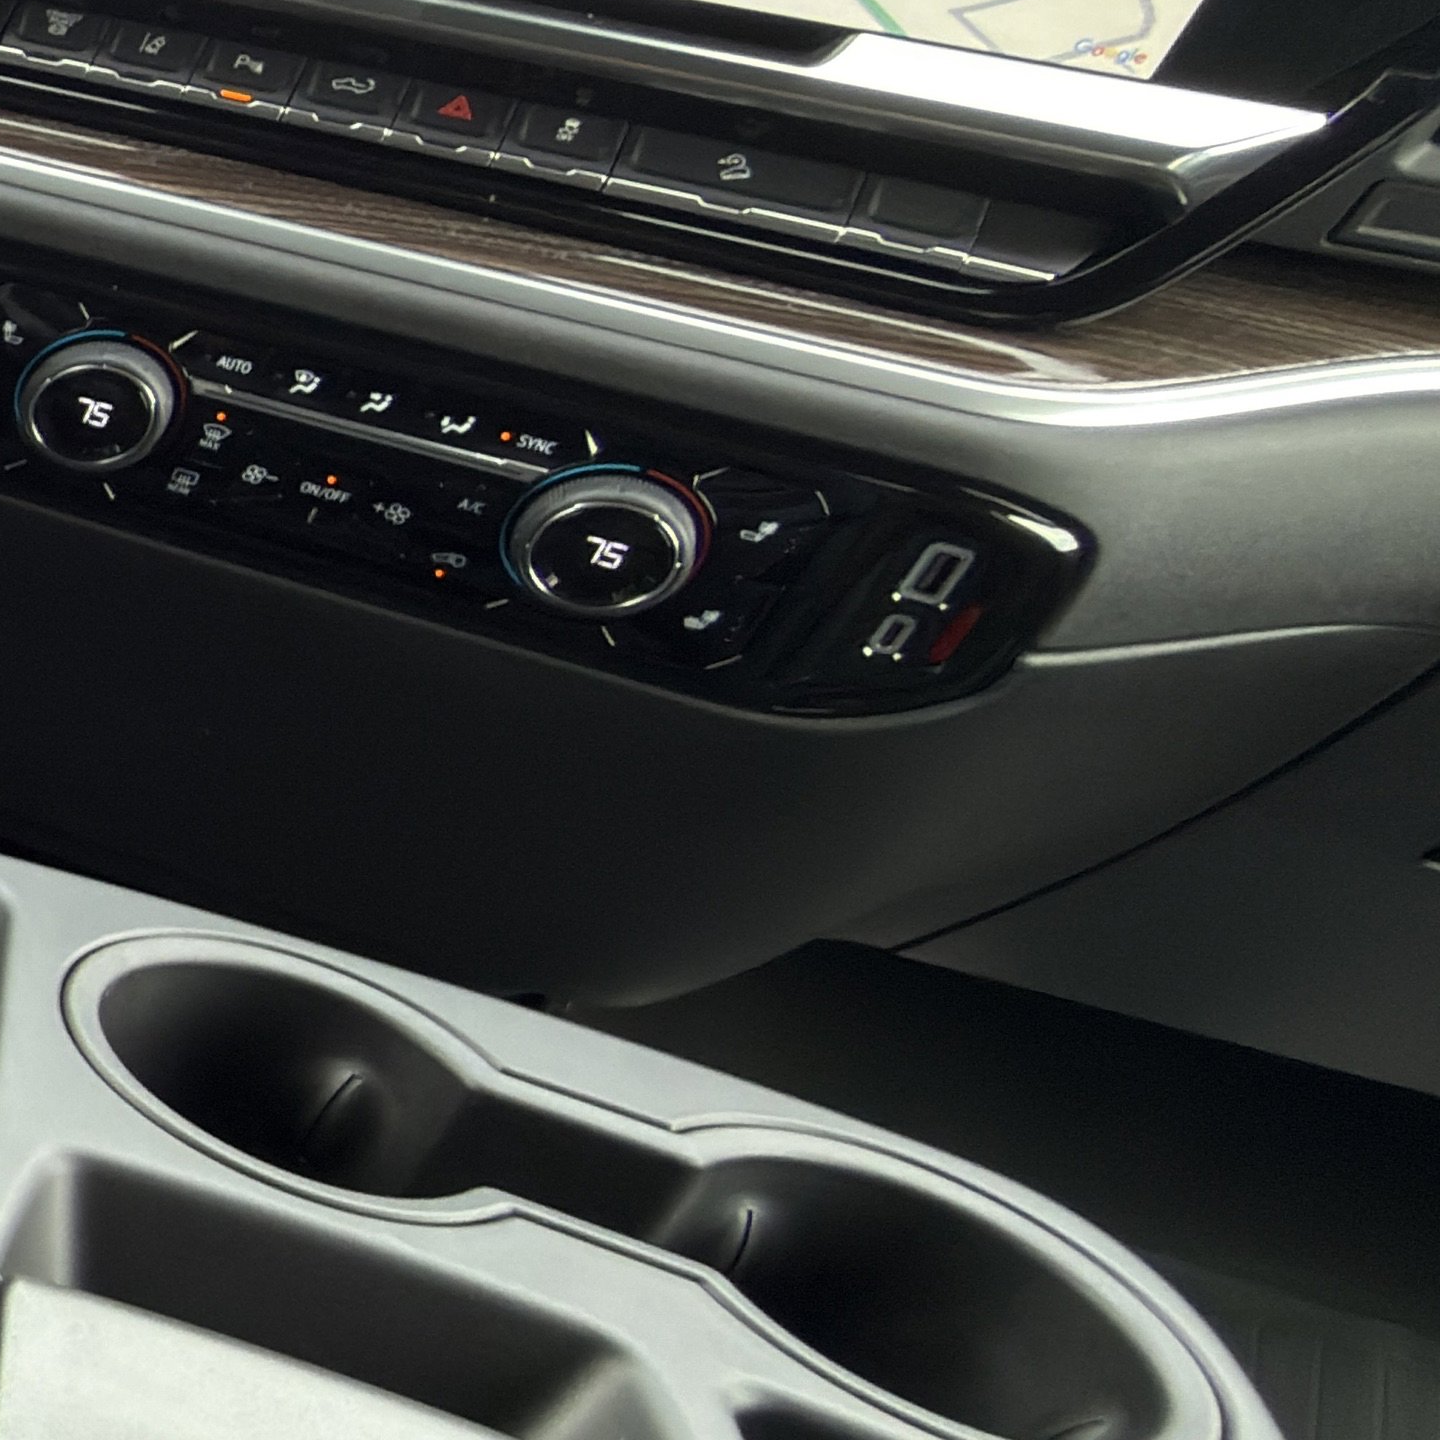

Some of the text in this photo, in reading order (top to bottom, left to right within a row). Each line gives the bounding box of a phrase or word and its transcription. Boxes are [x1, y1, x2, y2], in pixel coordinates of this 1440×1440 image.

[1074, 38, 1149, 65] Google
[216, 355, 252, 374] AUTO
[78, 396, 113, 428] 75
[516, 433, 559, 456] SYNC
[300, 480, 352, 503] ON/OFF
[457, 498, 486, 514] A/C
[587, 535, 629, 569] 75
